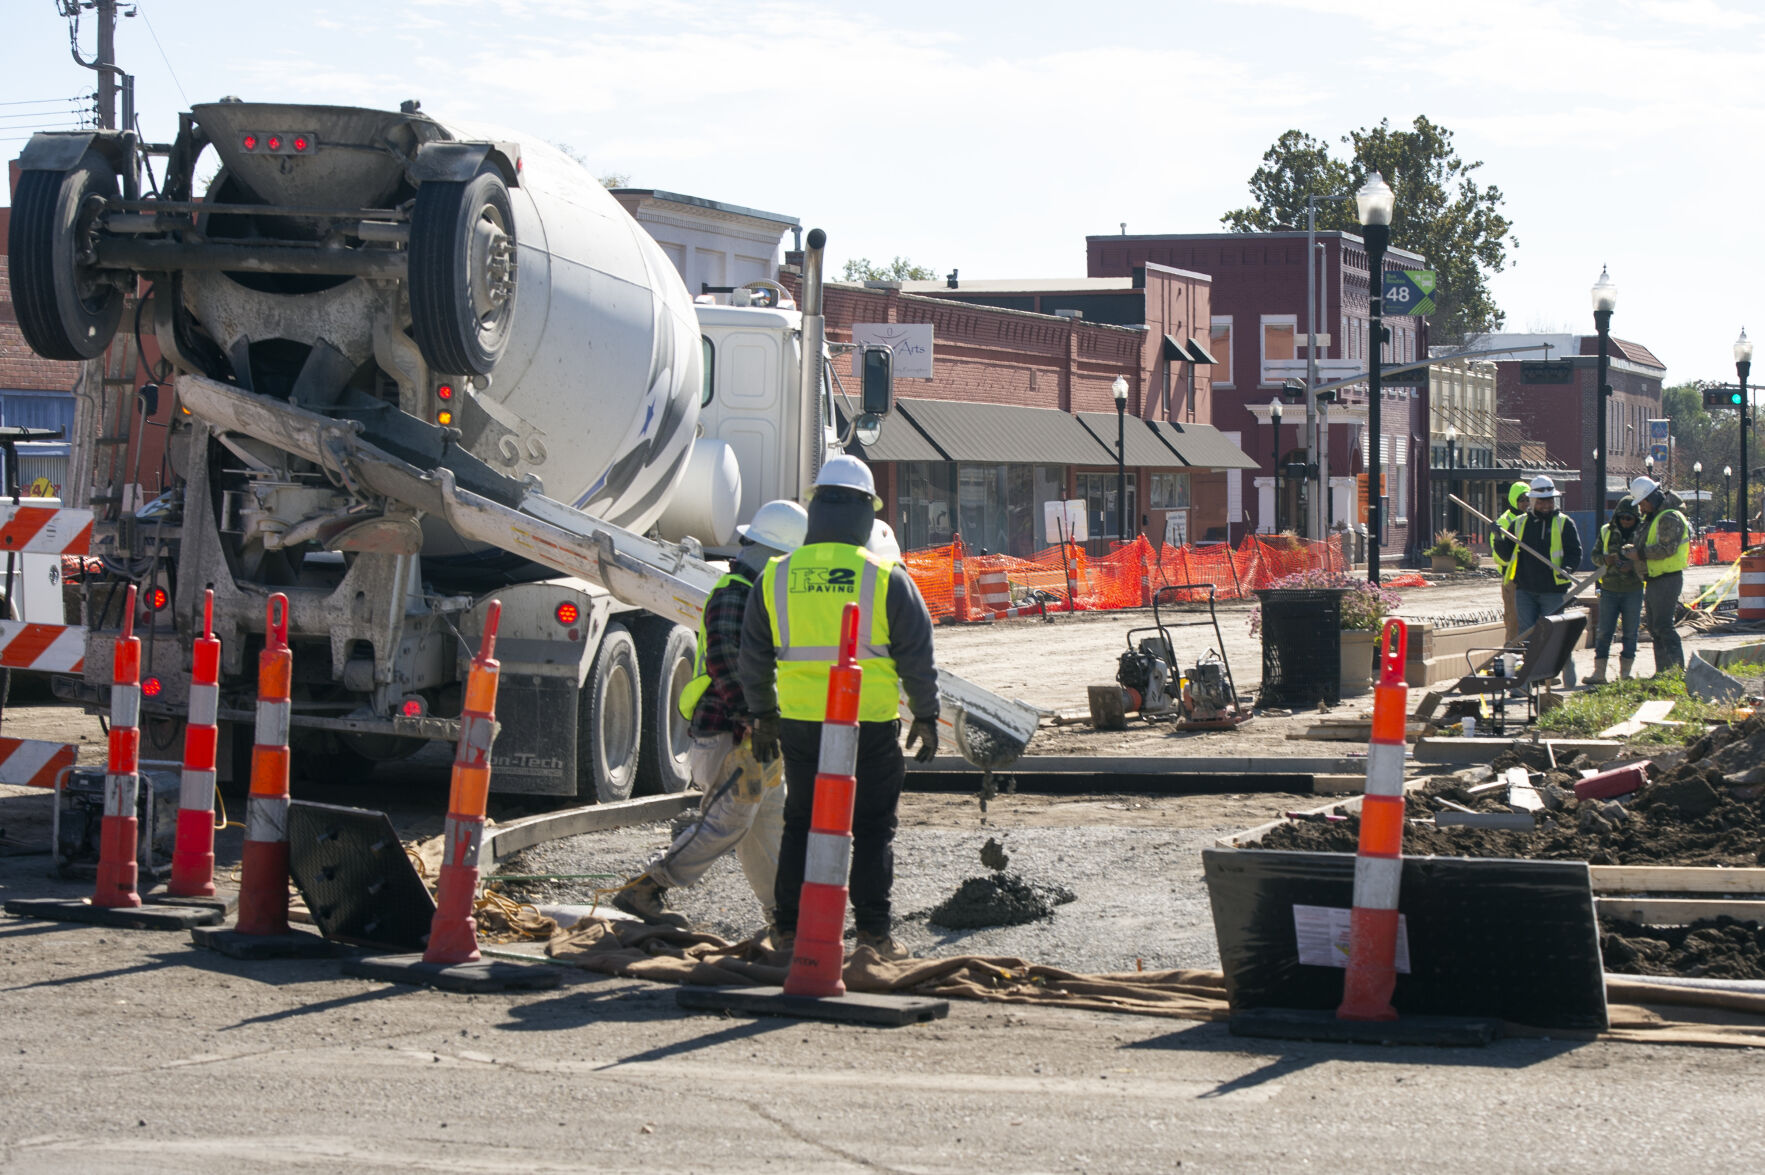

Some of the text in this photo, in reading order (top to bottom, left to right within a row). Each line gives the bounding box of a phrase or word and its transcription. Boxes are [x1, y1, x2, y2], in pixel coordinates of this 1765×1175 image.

[1386, 287, 1410, 302] 48
[898, 341, 926, 356] Arts
[790, 567, 856, 593] K2
[808, 585, 854, 593] PAVING
